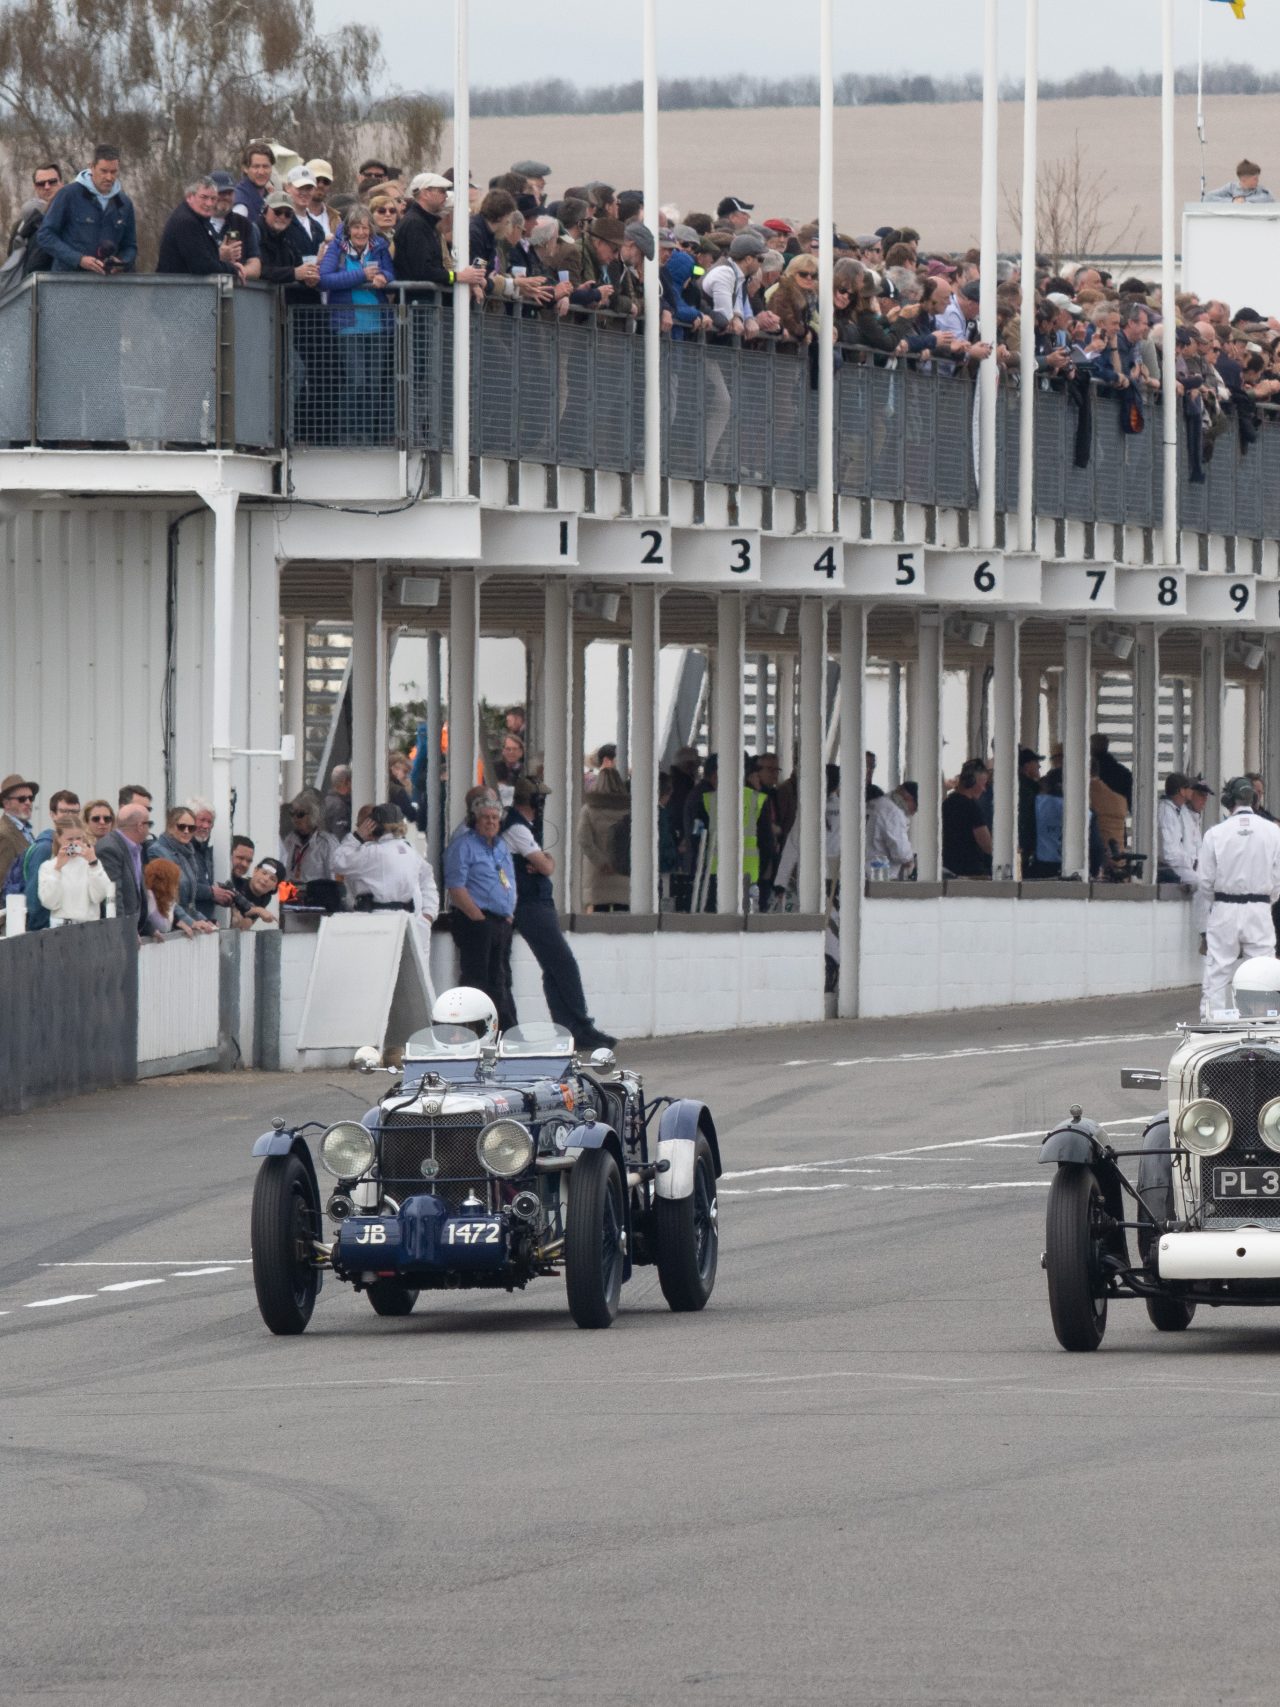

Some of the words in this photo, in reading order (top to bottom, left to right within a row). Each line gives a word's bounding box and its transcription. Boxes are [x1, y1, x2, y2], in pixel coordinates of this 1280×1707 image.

[559, 520, 568, 555] 1
[640, 529, 664, 564] 2
[730, 538, 751, 574] 3
[813, 546, 837, 579] 4
[895, 552, 916, 586] 5
[973, 560, 996, 593] 6
[1085, 570, 1107, 601] 7
[1157, 575, 1178, 606] 8
[1229, 583, 1249, 613] 9
[1221, 1171, 1258, 1195] PL
[1262, 1171, 1279, 1195] 3
[356, 1224, 387, 1244] JB
[448, 1223, 500, 1245] 1472
